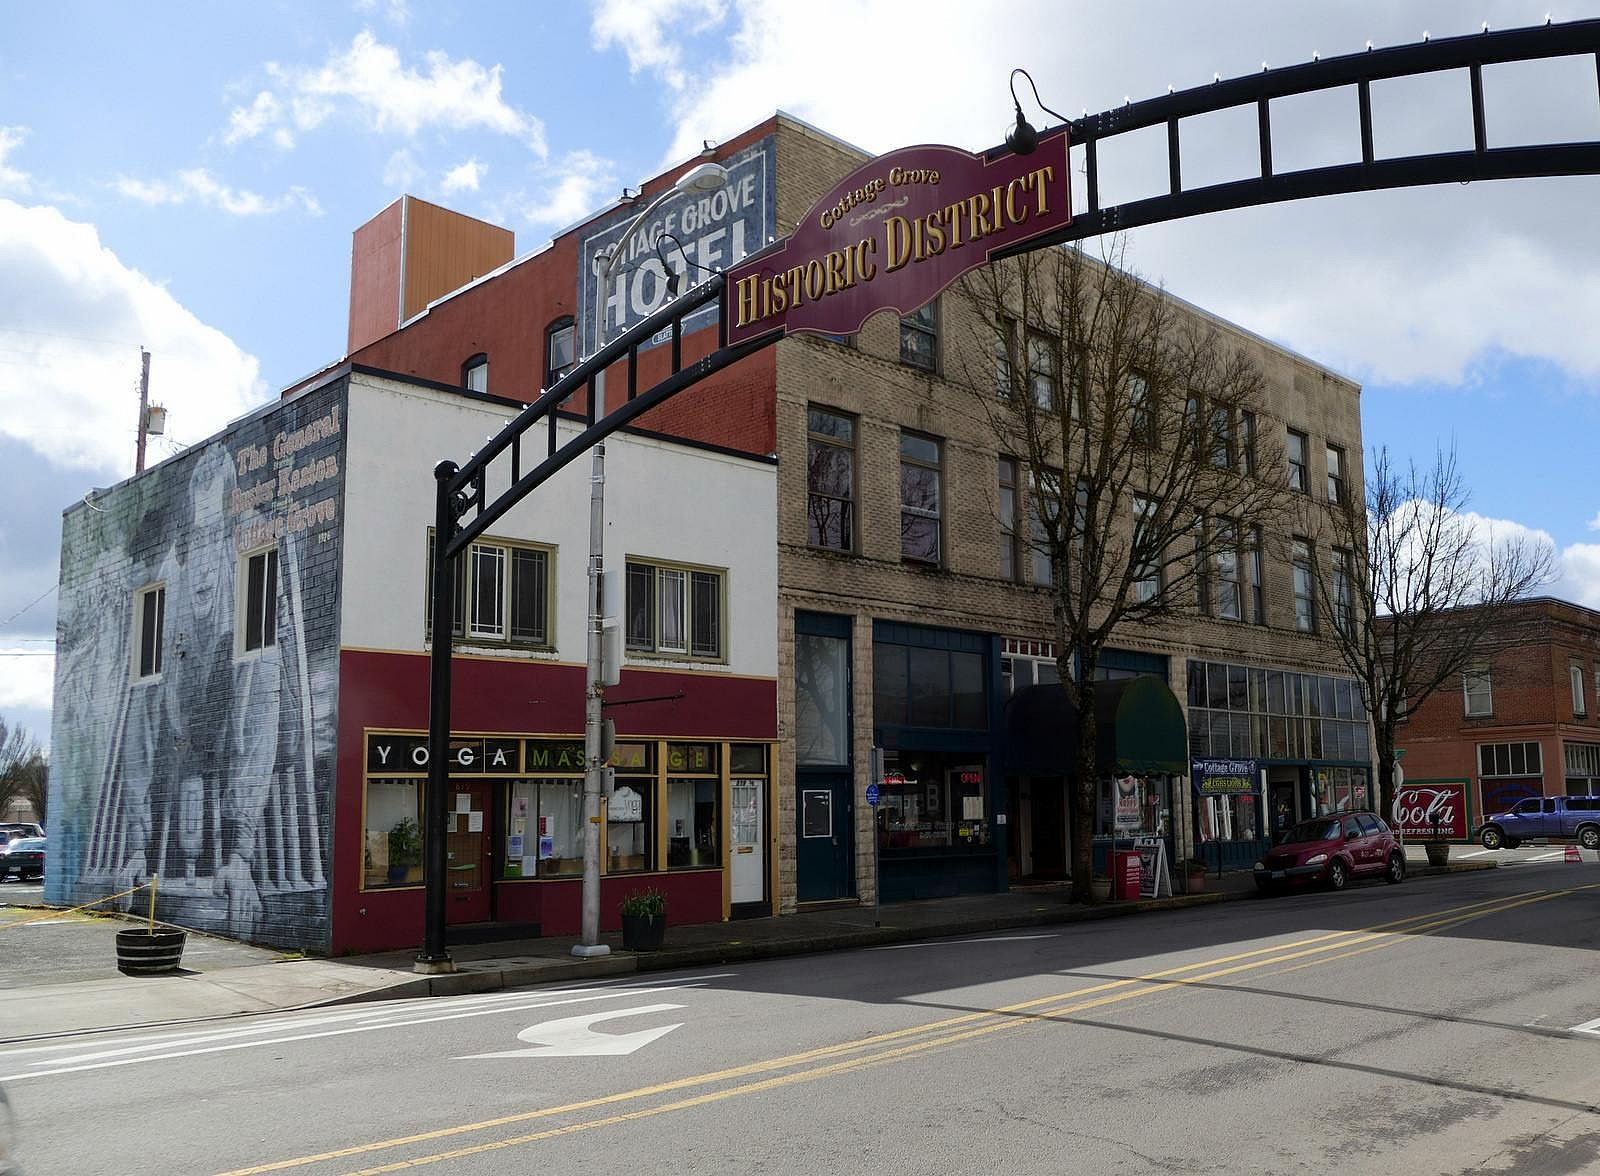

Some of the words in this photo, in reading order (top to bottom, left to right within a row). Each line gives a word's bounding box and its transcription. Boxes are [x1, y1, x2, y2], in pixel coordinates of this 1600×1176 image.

[680, 172, 756, 236] GROVE
[820, 178, 887, 230] Cottage
[889, 166, 942, 188] Grove
[736, 236, 877, 328] HISTORIC
[883, 165, 1055, 272] DISTRICT
[237, 443, 268, 477] The
[273, 404, 341, 461] General
[287, 499, 336, 534] Grove
[377, 744, 508, 768] YOGA
[532, 749, 704, 768] MASSAGE
[1392, 788, 1461, 826] Cola
